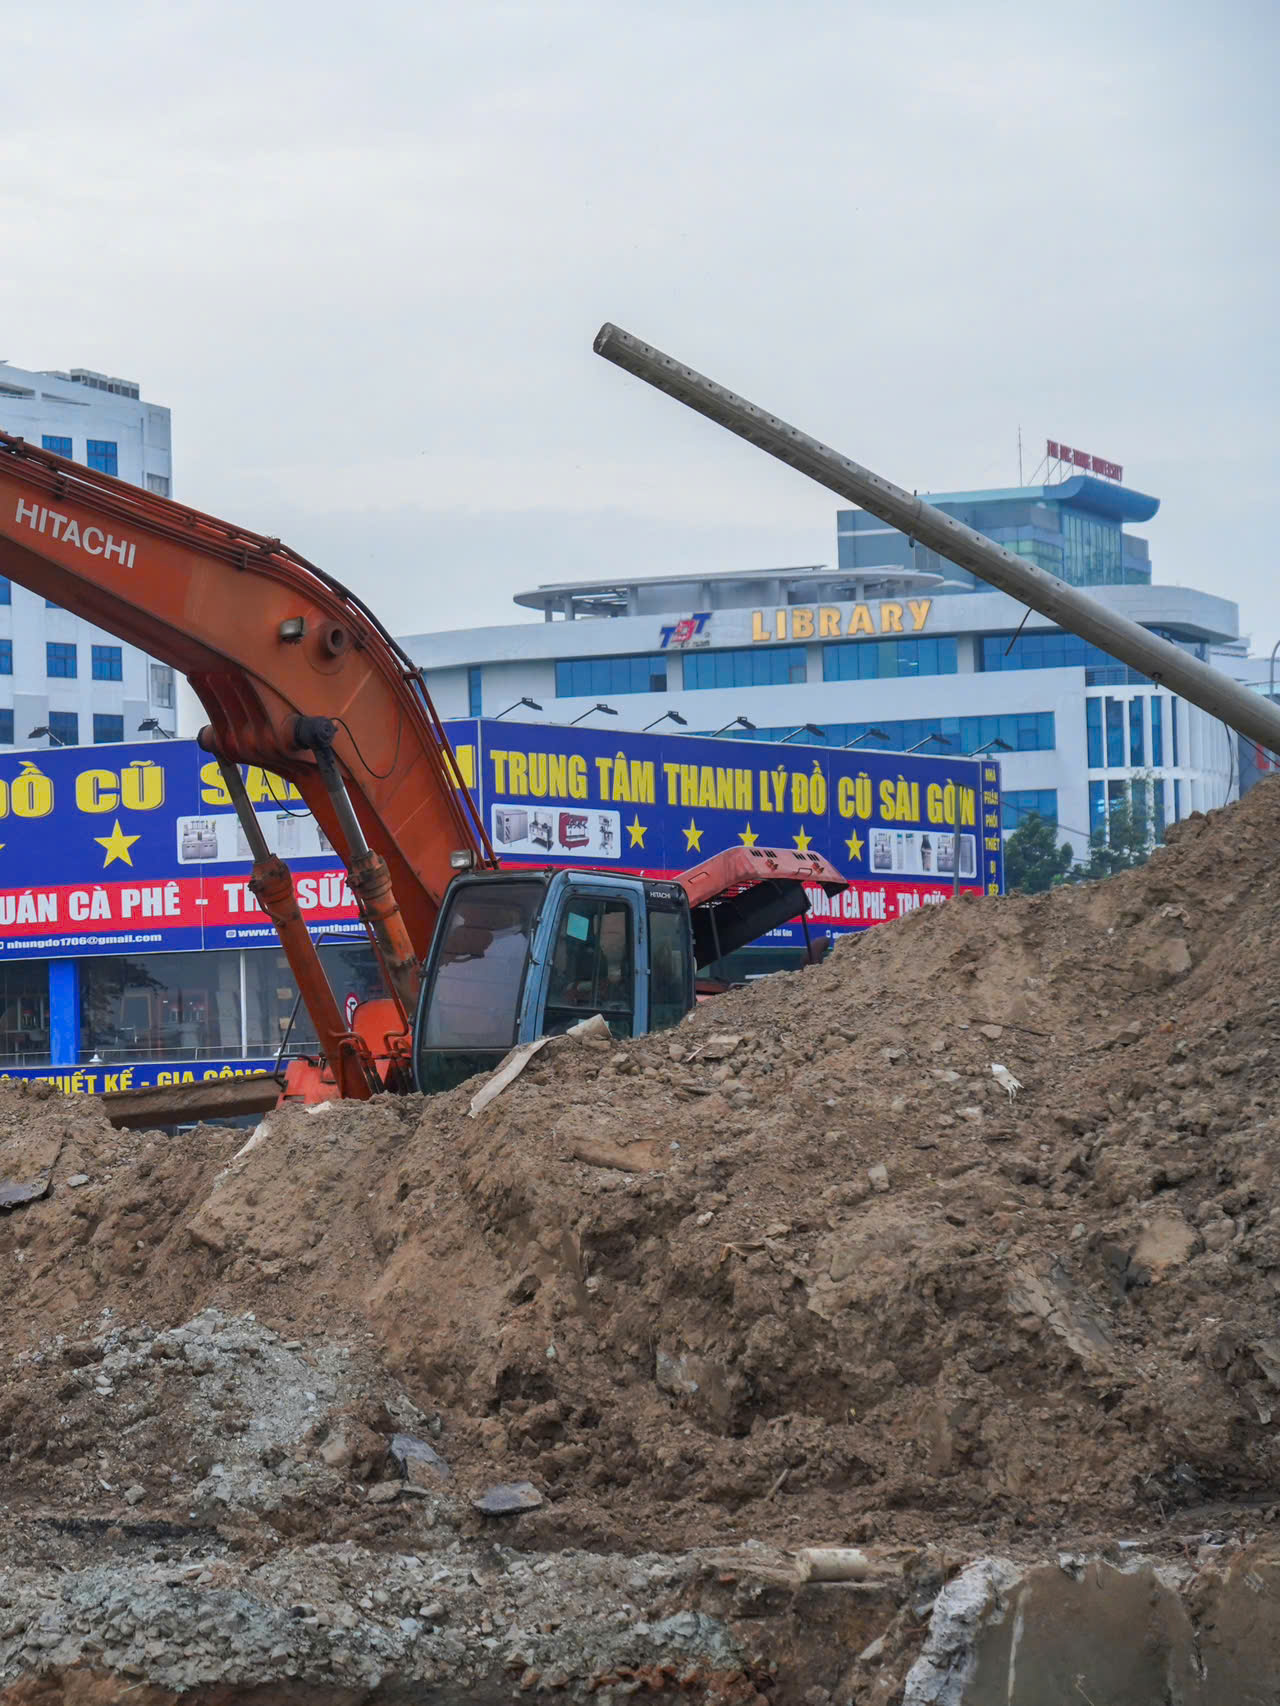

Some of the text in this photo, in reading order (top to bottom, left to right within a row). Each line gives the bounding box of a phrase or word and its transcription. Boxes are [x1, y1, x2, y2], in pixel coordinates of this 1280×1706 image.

[15, 498, 137, 569] HITACHI
[752, 599, 932, 643] LIBRARY
[75, 760, 165, 814] CŨ
[490, 749, 588, 800] TRUNG
[595, 751, 656, 805] TÂM
[663, 762, 754, 812] THANH
[760, 764, 788, 813] LÝ
[791, 759, 827, 816] ĐỒ
[837, 771, 873, 820] CŨ
[879, 775, 921, 823] SÀI
[927, 778, 977, 826] GÒN
[68, 888, 112, 921] CÀ
[120, 881, 181, 918] PHÊ
[650, 891, 671, 899] HITACHI
[842, 887, 861, 919] CÀ
[862, 887, 887, 920] PHÊ
[6, 934, 162, 950] nhungdo1706@gmail.com
[105, 1066, 135, 1092] KẾ
[157, 1071, 195, 1087] GIA
